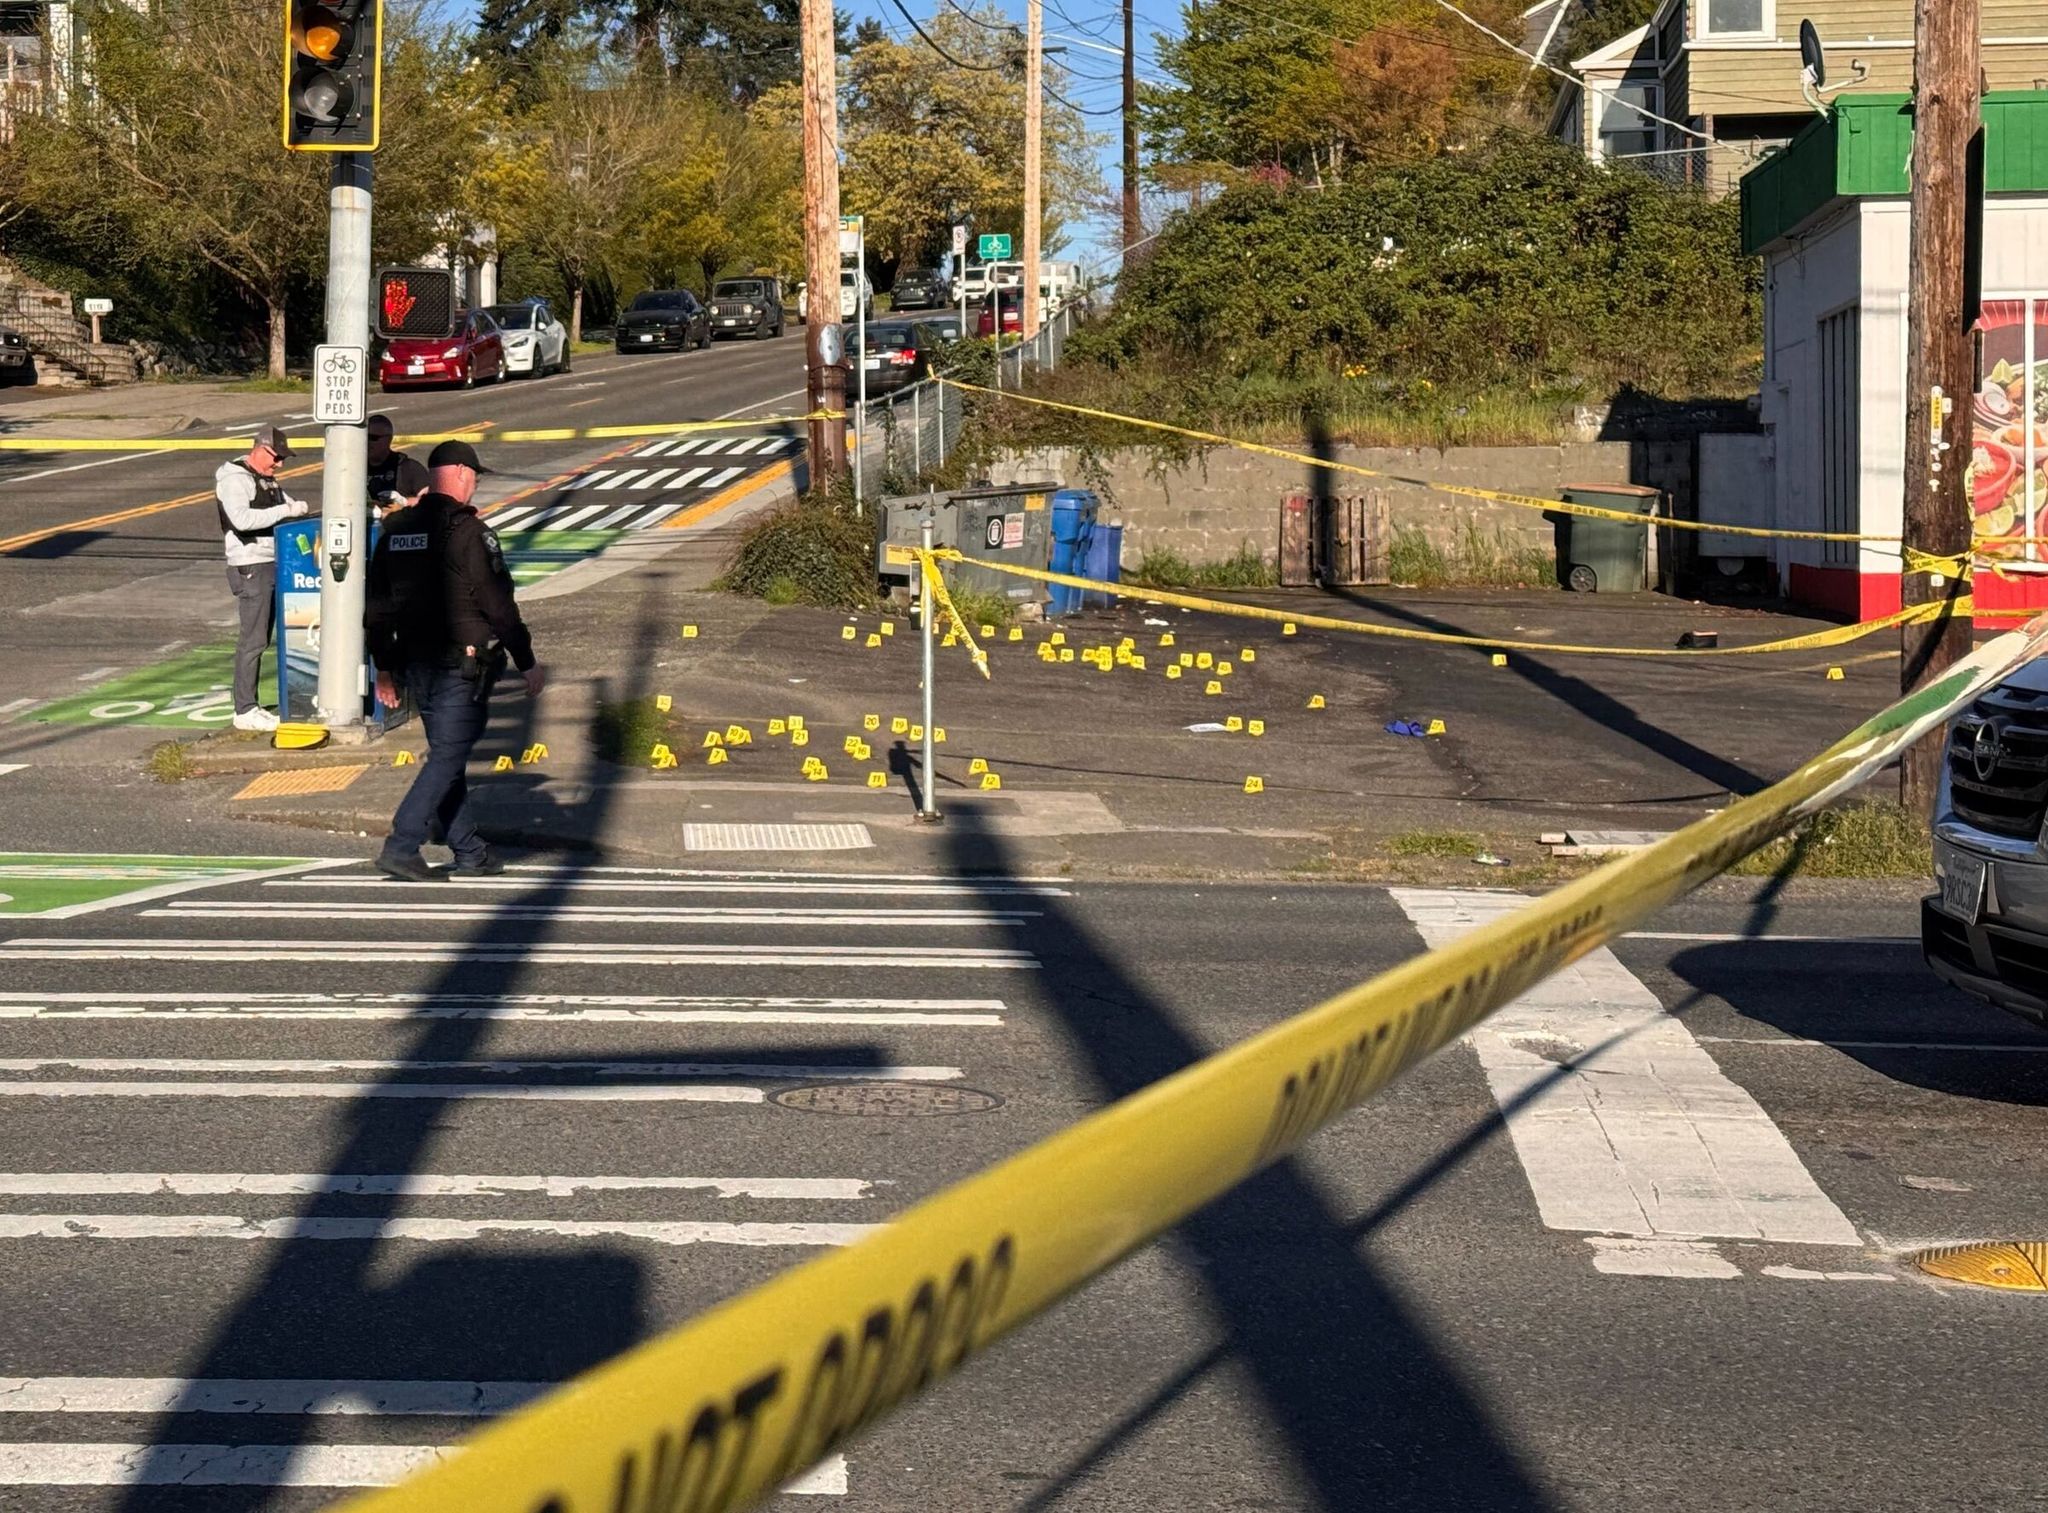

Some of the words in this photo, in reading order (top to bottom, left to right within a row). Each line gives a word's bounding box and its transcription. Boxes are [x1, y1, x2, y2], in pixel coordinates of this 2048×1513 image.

[326, 376, 353, 387] STOP
[329, 389, 349, 401] FOR
[325, 403, 353, 415] PEDS
[392, 536, 426, 549] POLICE
[294, 573, 322, 588] Rec
[1945, 873, 1976, 914] 9RSC3
